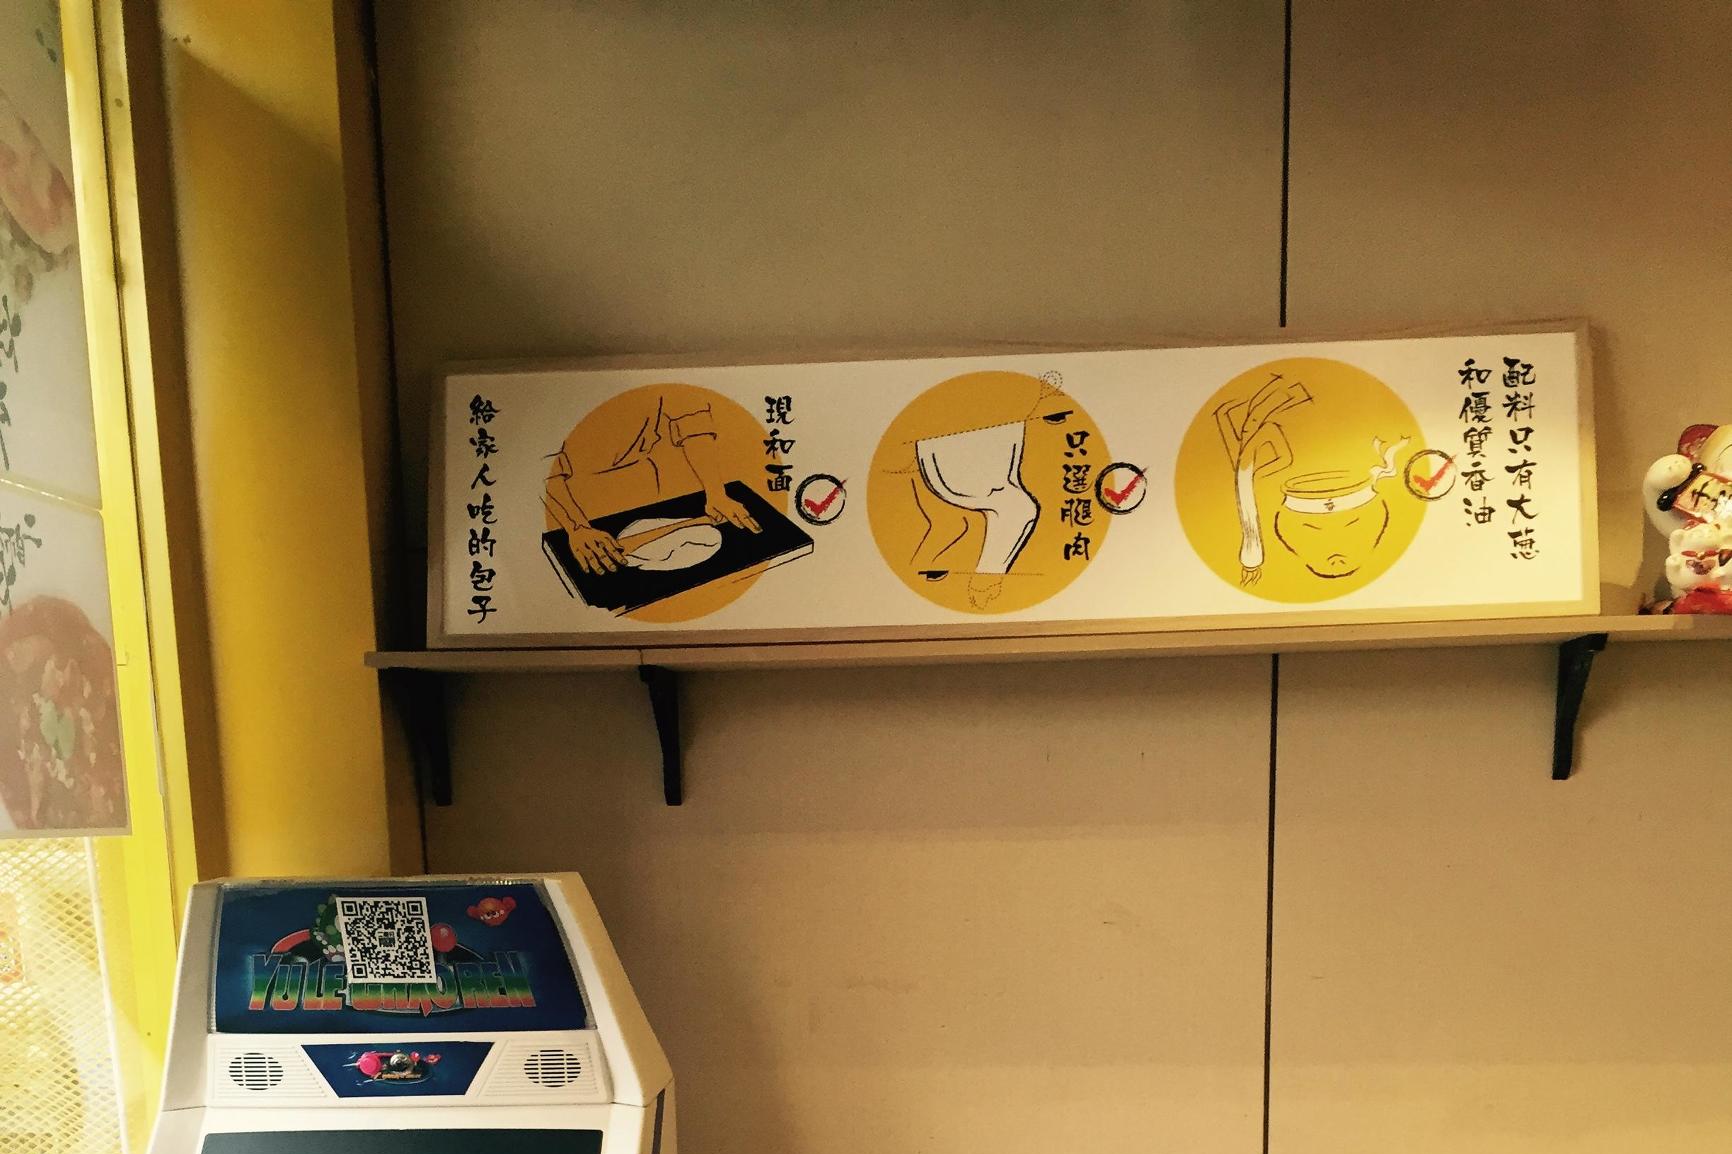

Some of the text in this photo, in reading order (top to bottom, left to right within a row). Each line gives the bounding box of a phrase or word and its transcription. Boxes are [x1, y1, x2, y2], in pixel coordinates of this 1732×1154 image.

[467, 394, 501, 624] 給家人吃的包子
[764, 395, 796, 493] 現和面
[1061, 430, 1094, 562] 只選腿肉
[1458, 358, 1496, 527] 和優質香油
